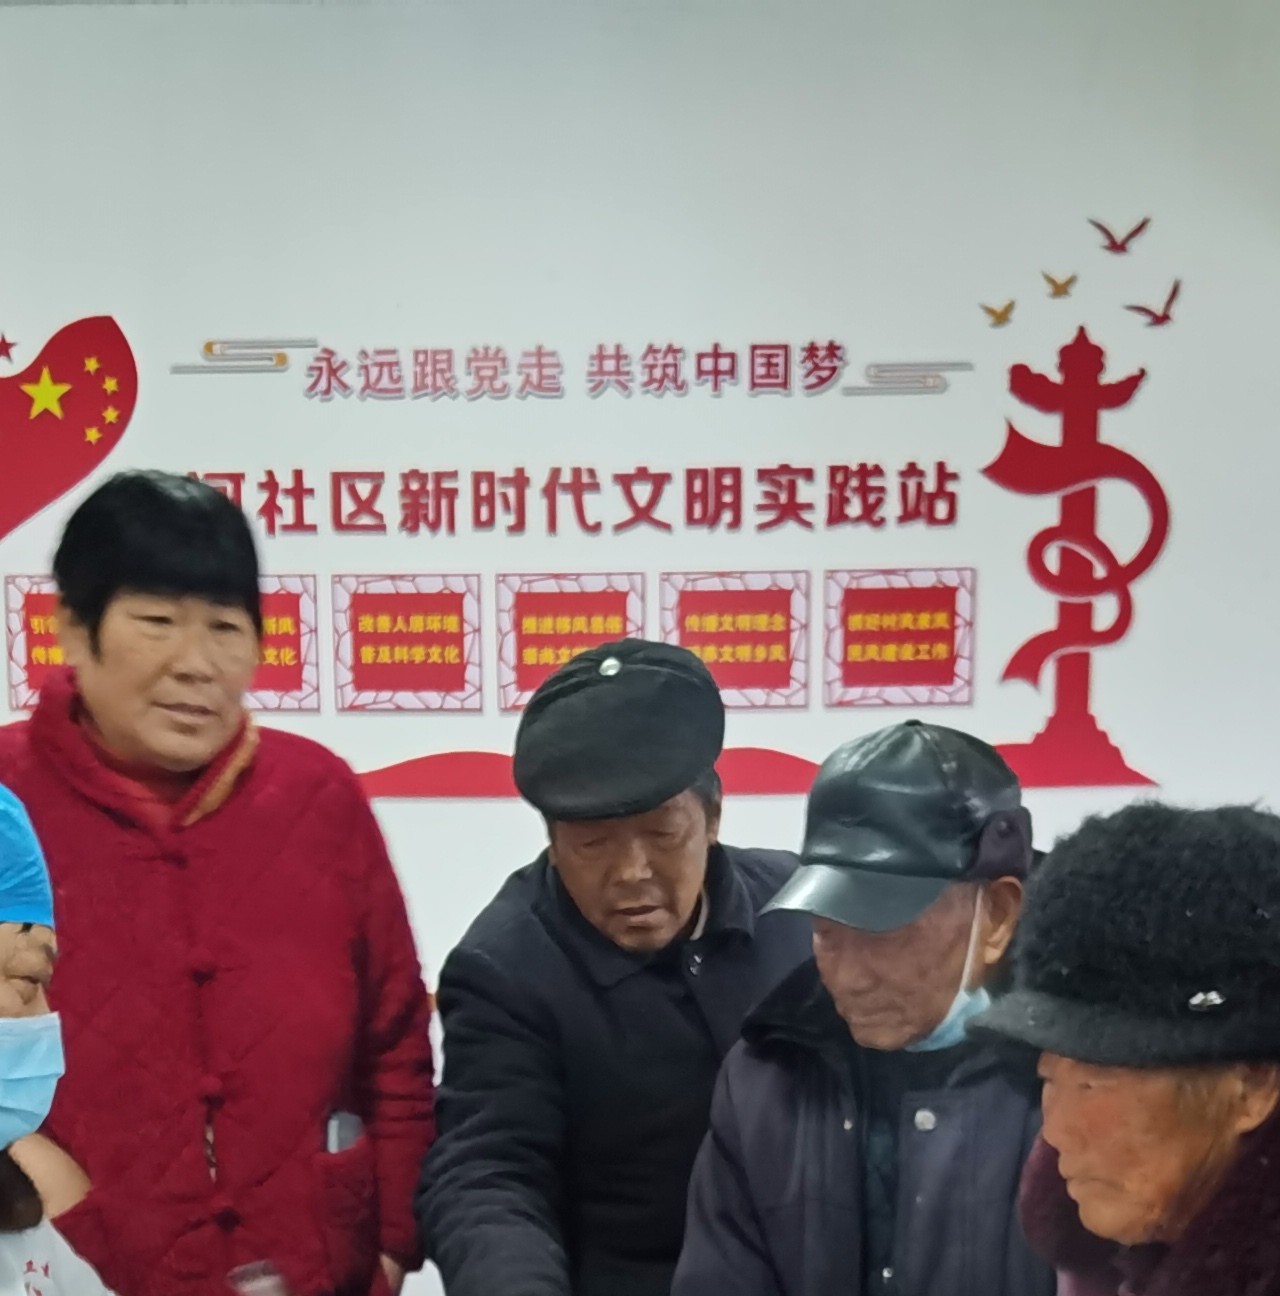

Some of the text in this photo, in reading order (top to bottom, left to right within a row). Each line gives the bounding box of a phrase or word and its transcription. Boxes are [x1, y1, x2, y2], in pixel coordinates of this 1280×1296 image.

[306, 340, 847, 398] 永远跟党走 共筑中国梦
